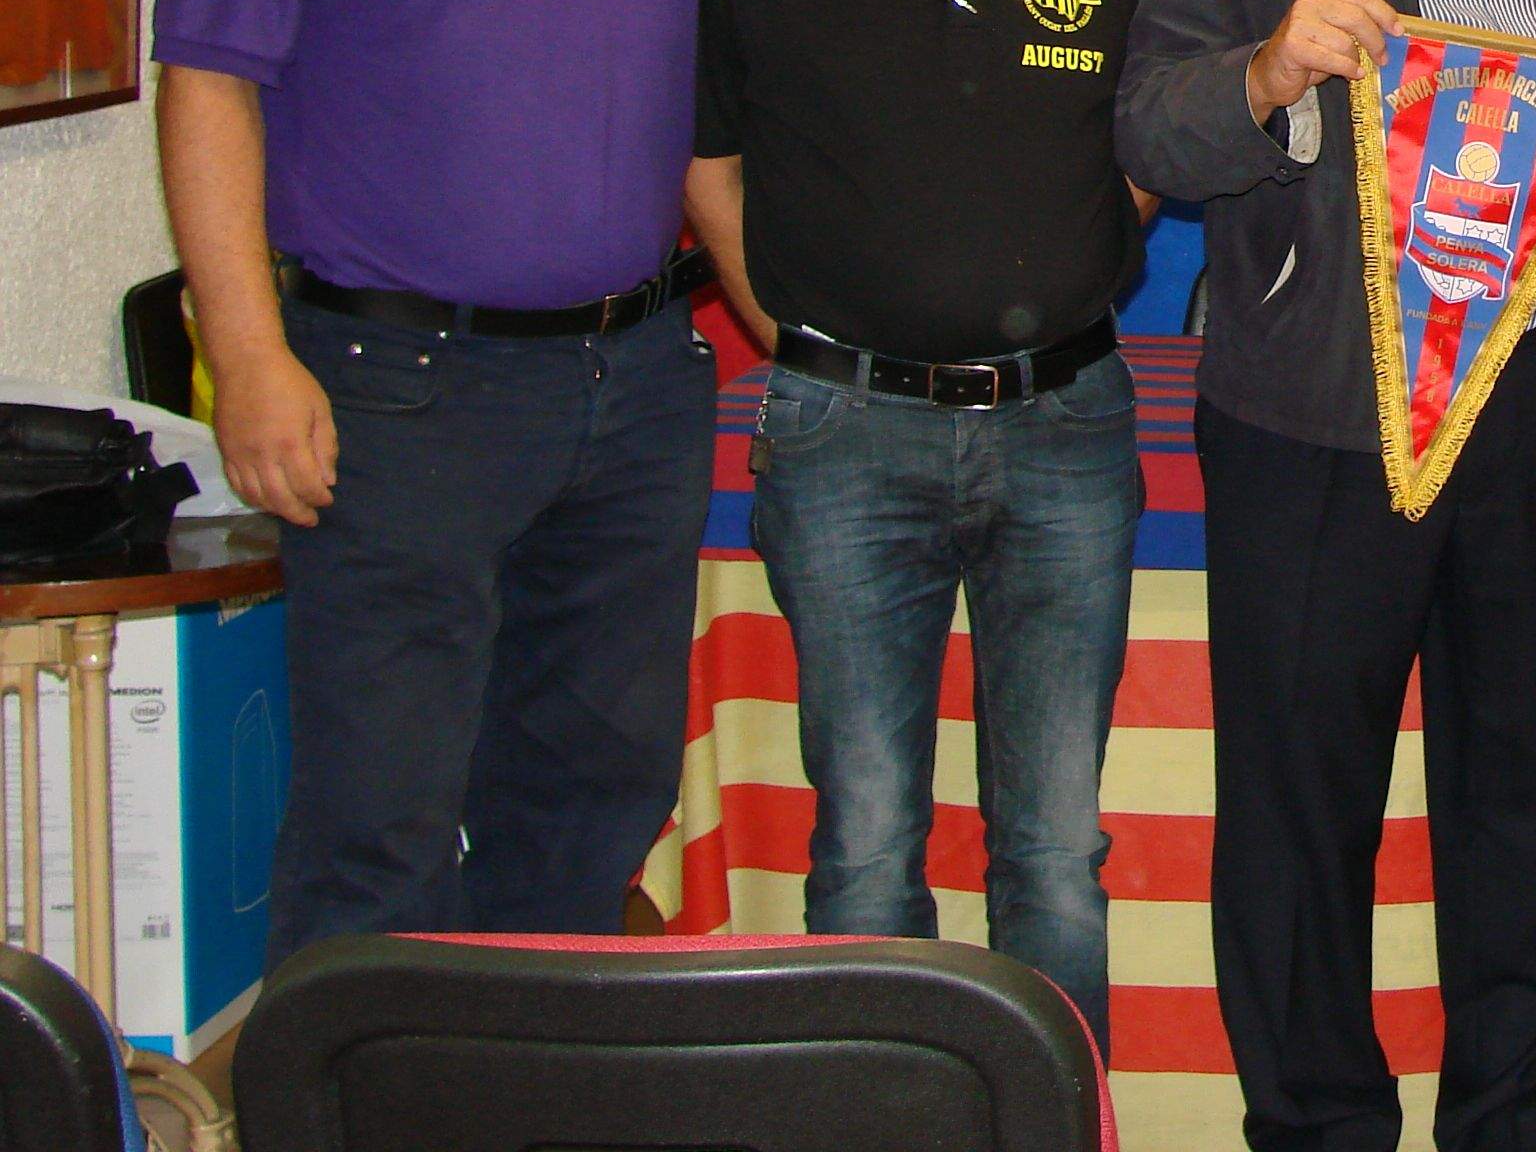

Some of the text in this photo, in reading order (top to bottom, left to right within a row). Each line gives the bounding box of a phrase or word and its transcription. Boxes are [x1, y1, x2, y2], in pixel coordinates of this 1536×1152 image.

[1021, 44, 1104, 74] AUGUST
[1384, 75, 1435, 114] PENYA
[1432, 66, 1491, 92] SOLERA
[1456, 100, 1520, 134] CALELLA
[1435, 235, 1484, 255] PENYA
[1426, 252, 1489, 274] SOLERA
